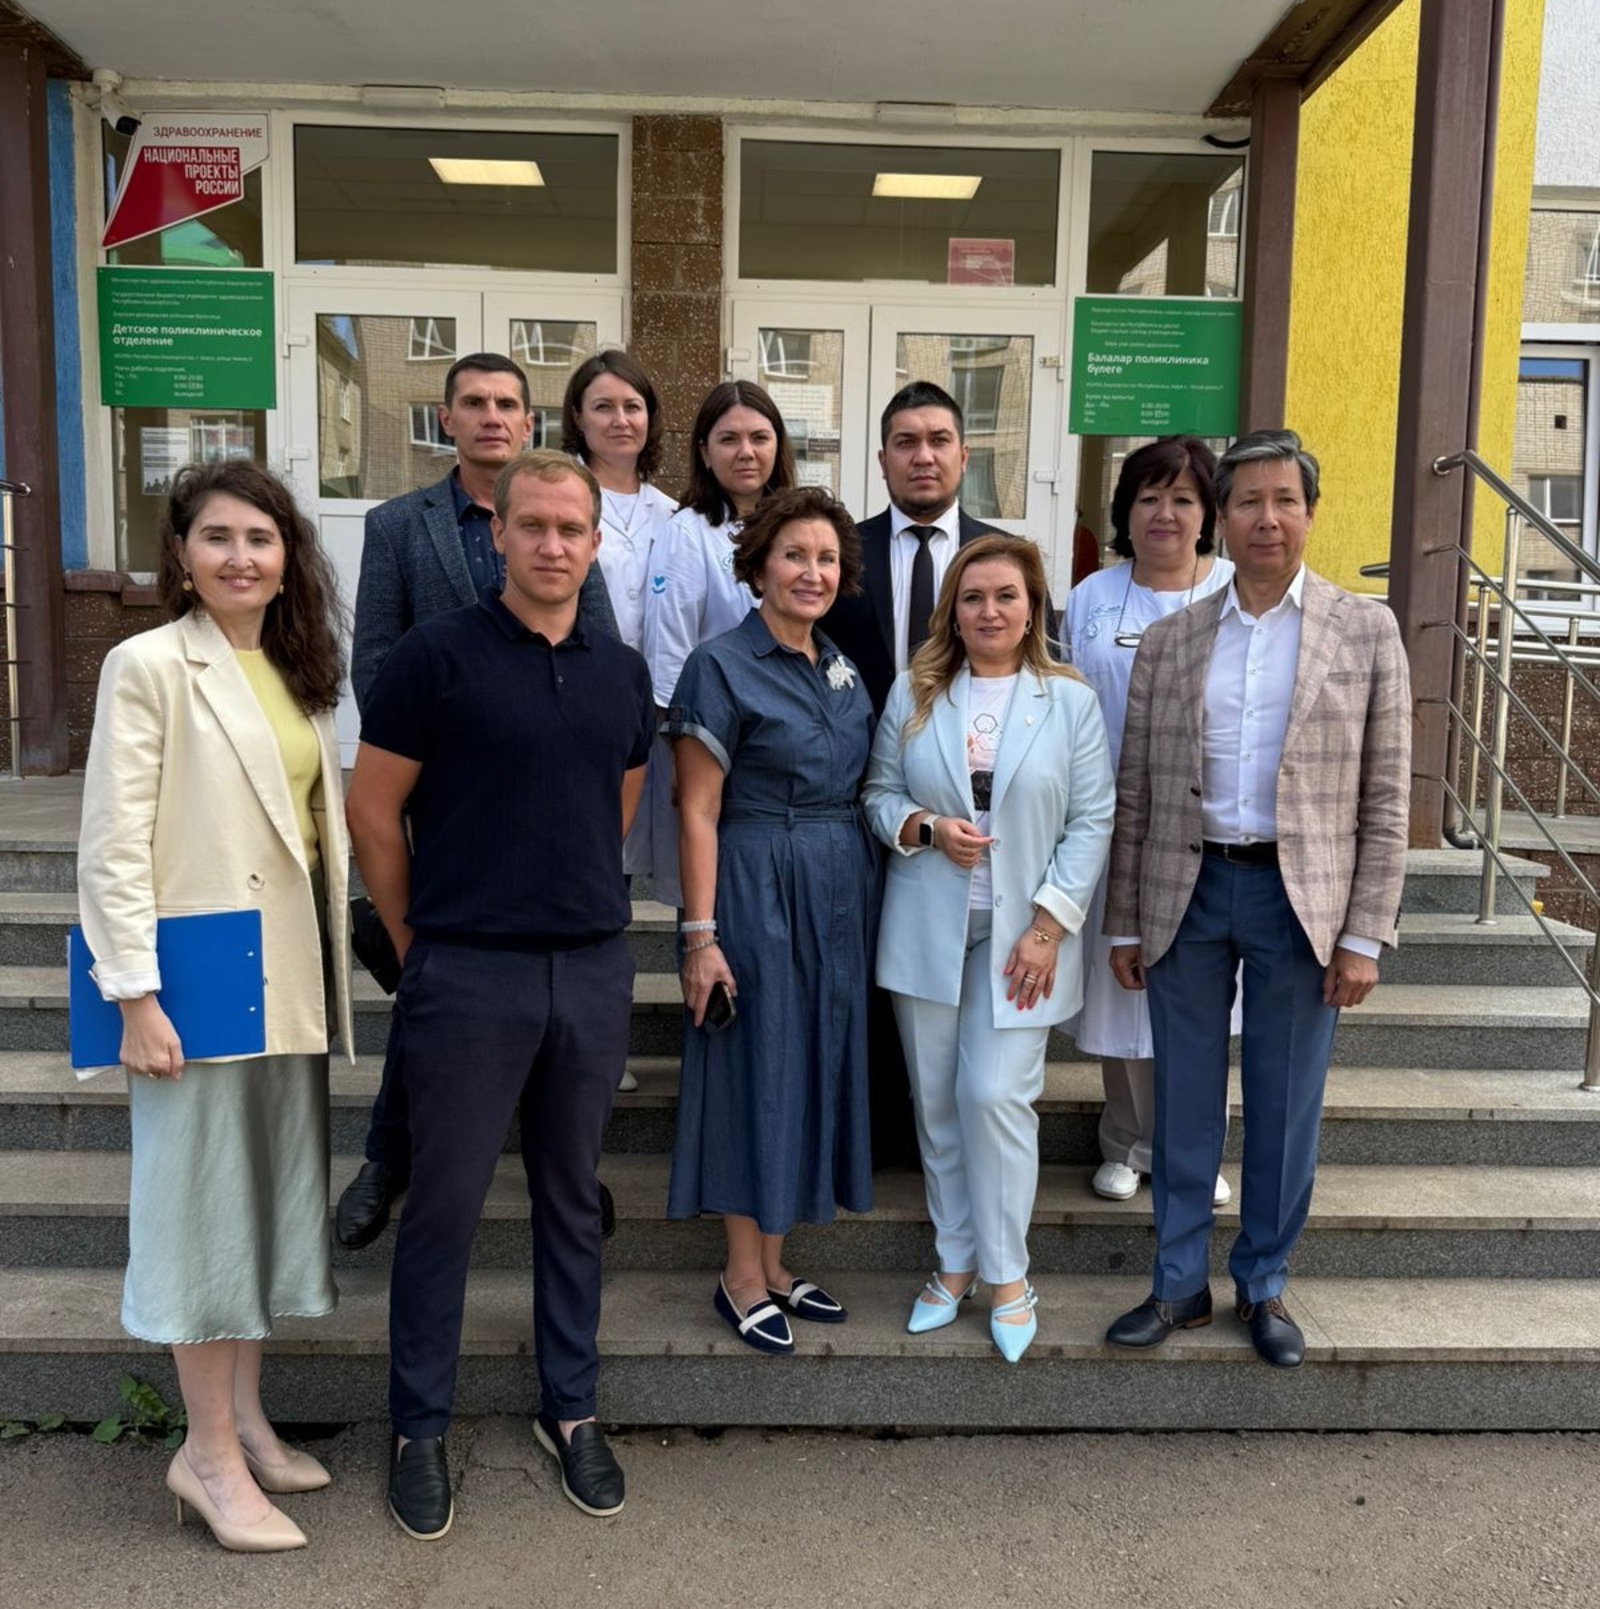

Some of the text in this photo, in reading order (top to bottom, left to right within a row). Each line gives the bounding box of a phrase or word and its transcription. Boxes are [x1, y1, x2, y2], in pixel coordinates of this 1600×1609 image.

[153, 126, 263, 139] ЗДРАВООХРАНЕНИЕ
[143, 148, 239, 164] НАЦИОНАЛЬНЫЕ
[184, 164, 239, 179] ПРОЕКТЫ
[195, 180, 240, 195] РОССИИ
[112, 323, 263, 337] Детское поликлиническое
[112, 336, 174, 346] отделение
[1087, 352, 1210, 365] Балалар поликлиника
